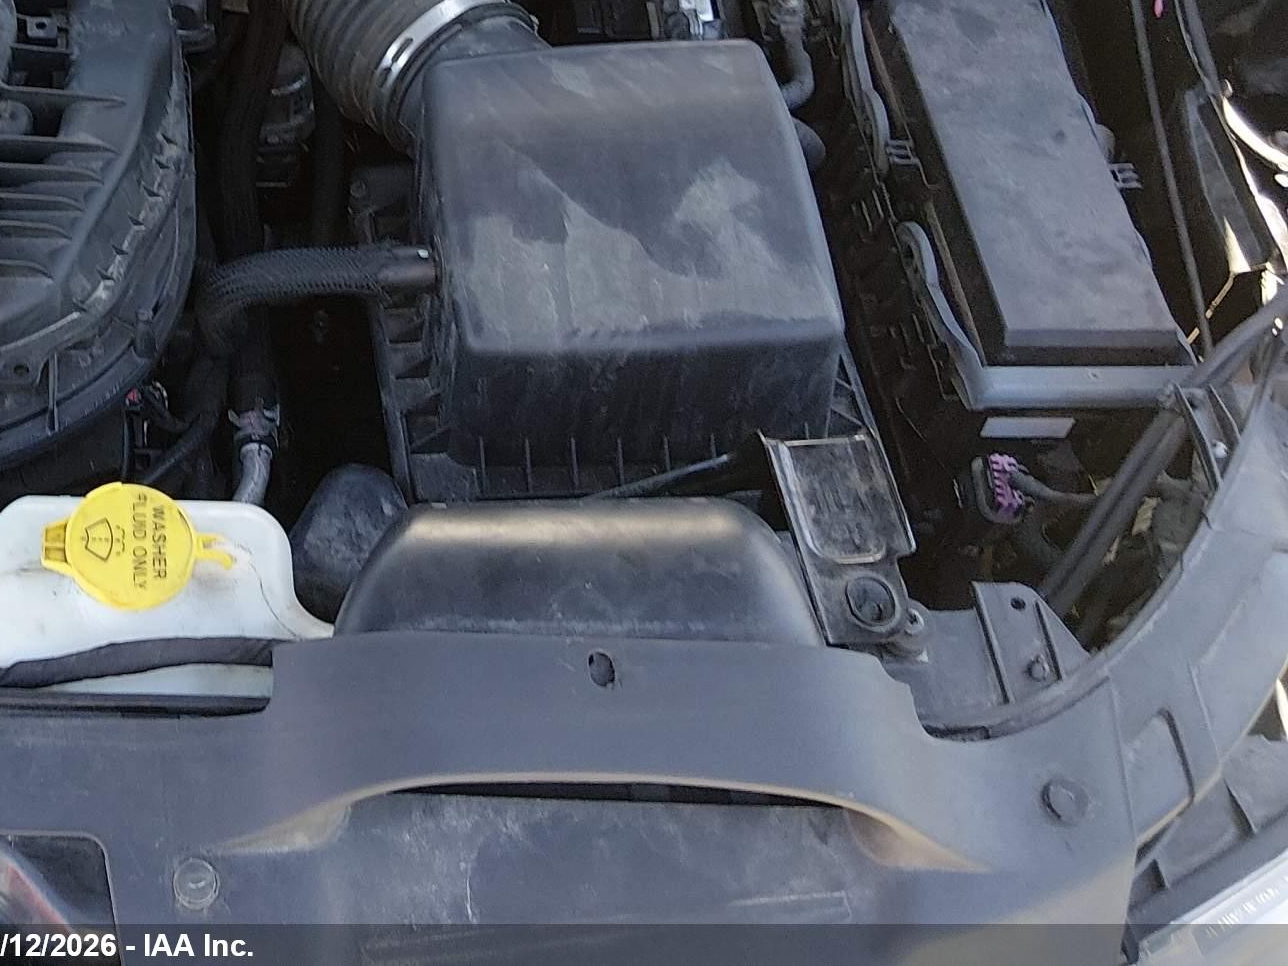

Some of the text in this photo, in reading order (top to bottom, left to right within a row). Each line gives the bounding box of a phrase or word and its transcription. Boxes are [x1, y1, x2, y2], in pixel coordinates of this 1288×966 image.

[133, 493, 147, 589] FLUID ONLY
[152, 503, 167, 579] WASHER
